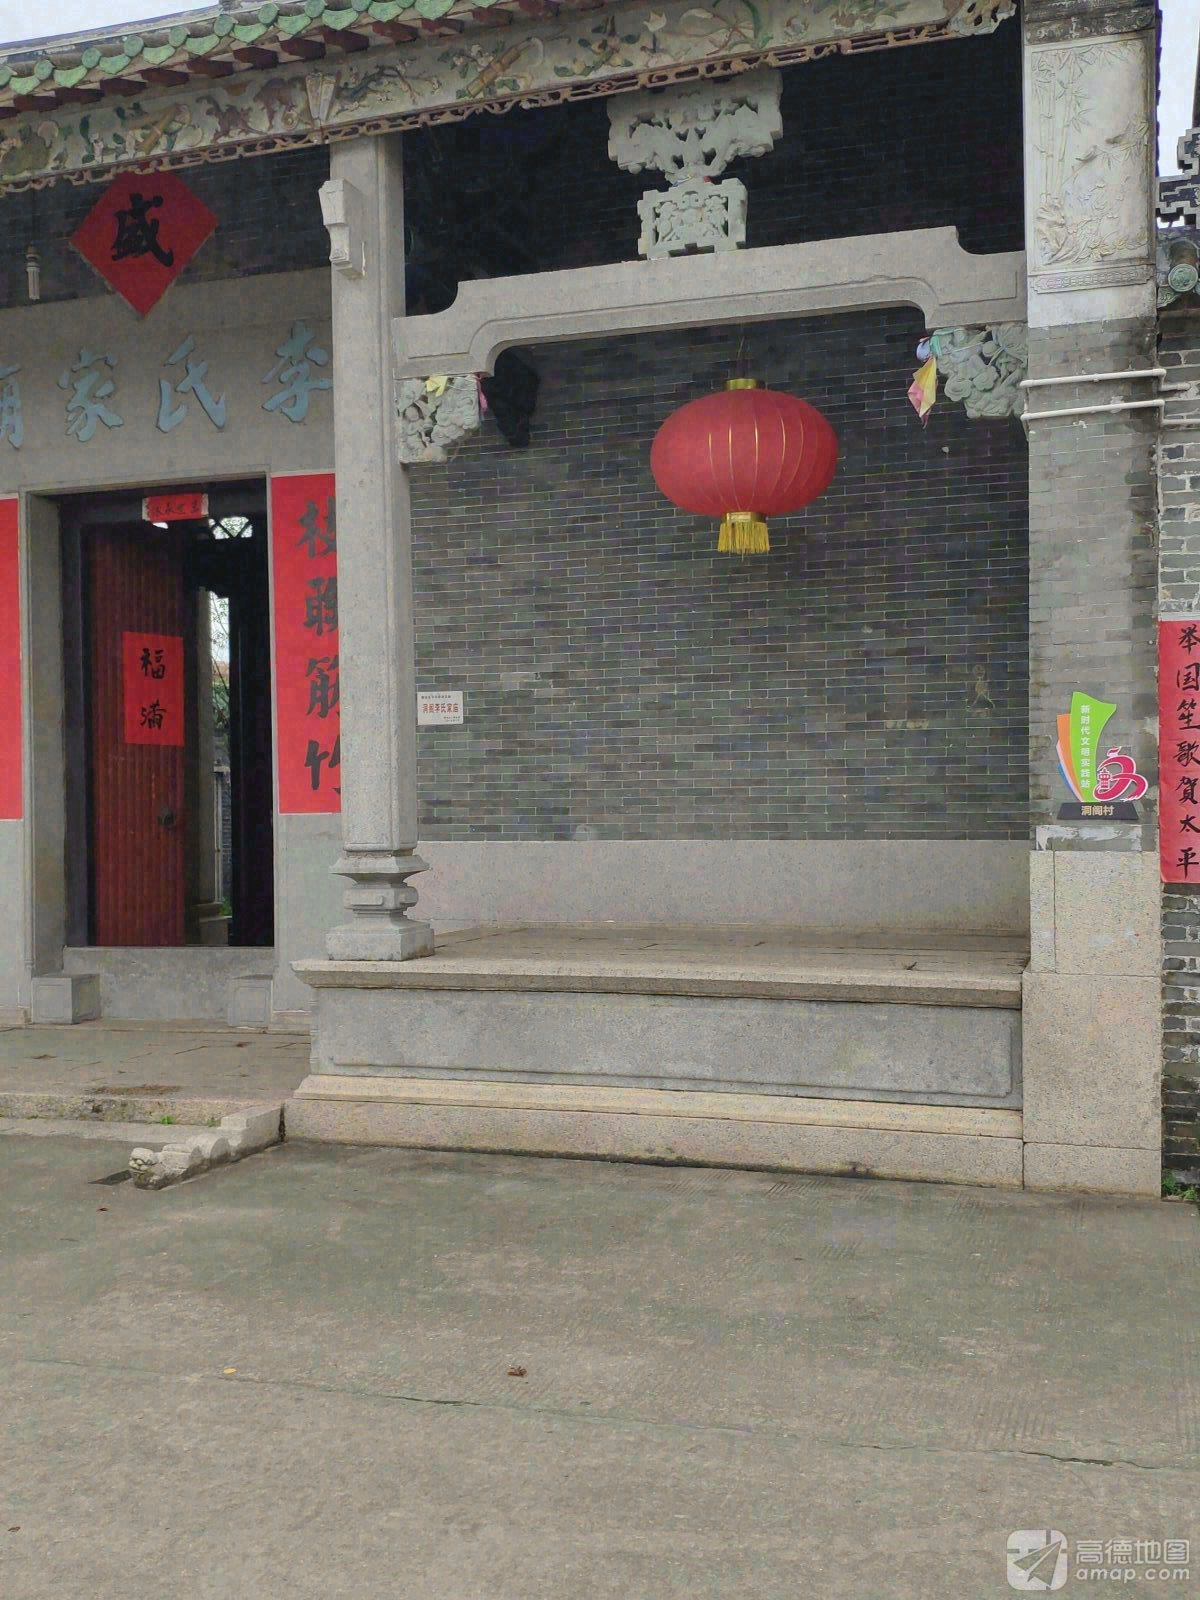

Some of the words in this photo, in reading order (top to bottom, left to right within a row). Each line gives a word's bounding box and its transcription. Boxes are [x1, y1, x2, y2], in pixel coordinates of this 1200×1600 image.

[1080, 705, 1091, 788] 新时代文明实践站
